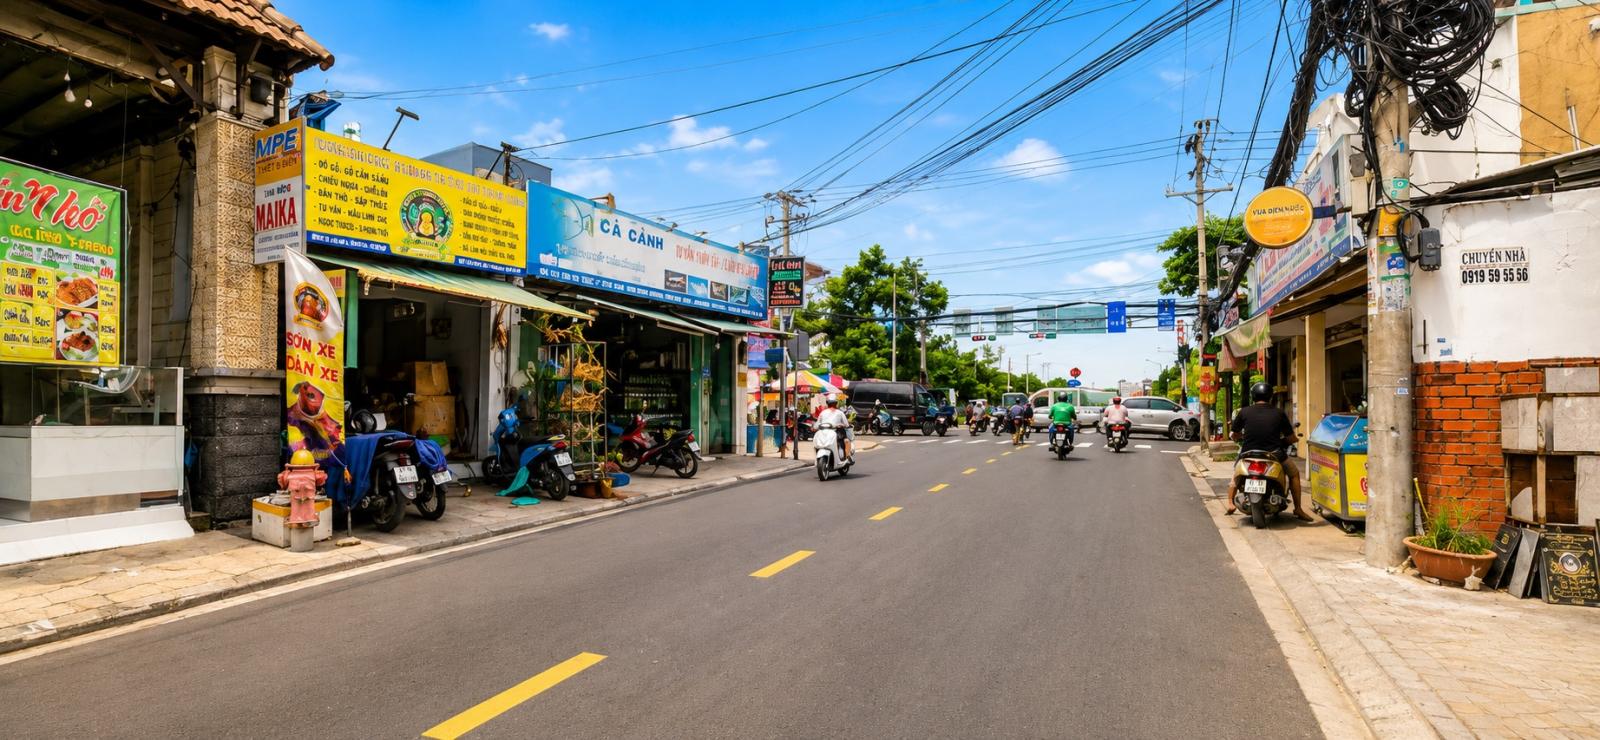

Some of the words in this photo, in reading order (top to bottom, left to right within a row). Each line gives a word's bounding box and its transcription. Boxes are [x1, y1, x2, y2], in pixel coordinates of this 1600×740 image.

[256, 127, 298, 160] MPE
[256, 197, 298, 232] MAIKA
[1462, 269, 1485, 284] 0919
[1488, 269, 1501, 282] 59
[1503, 268, 1515, 282] 55
[1516, 267, 1529, 281] 56
[317, 342, 336, 359] XE
[320, 366, 338, 382] XE
